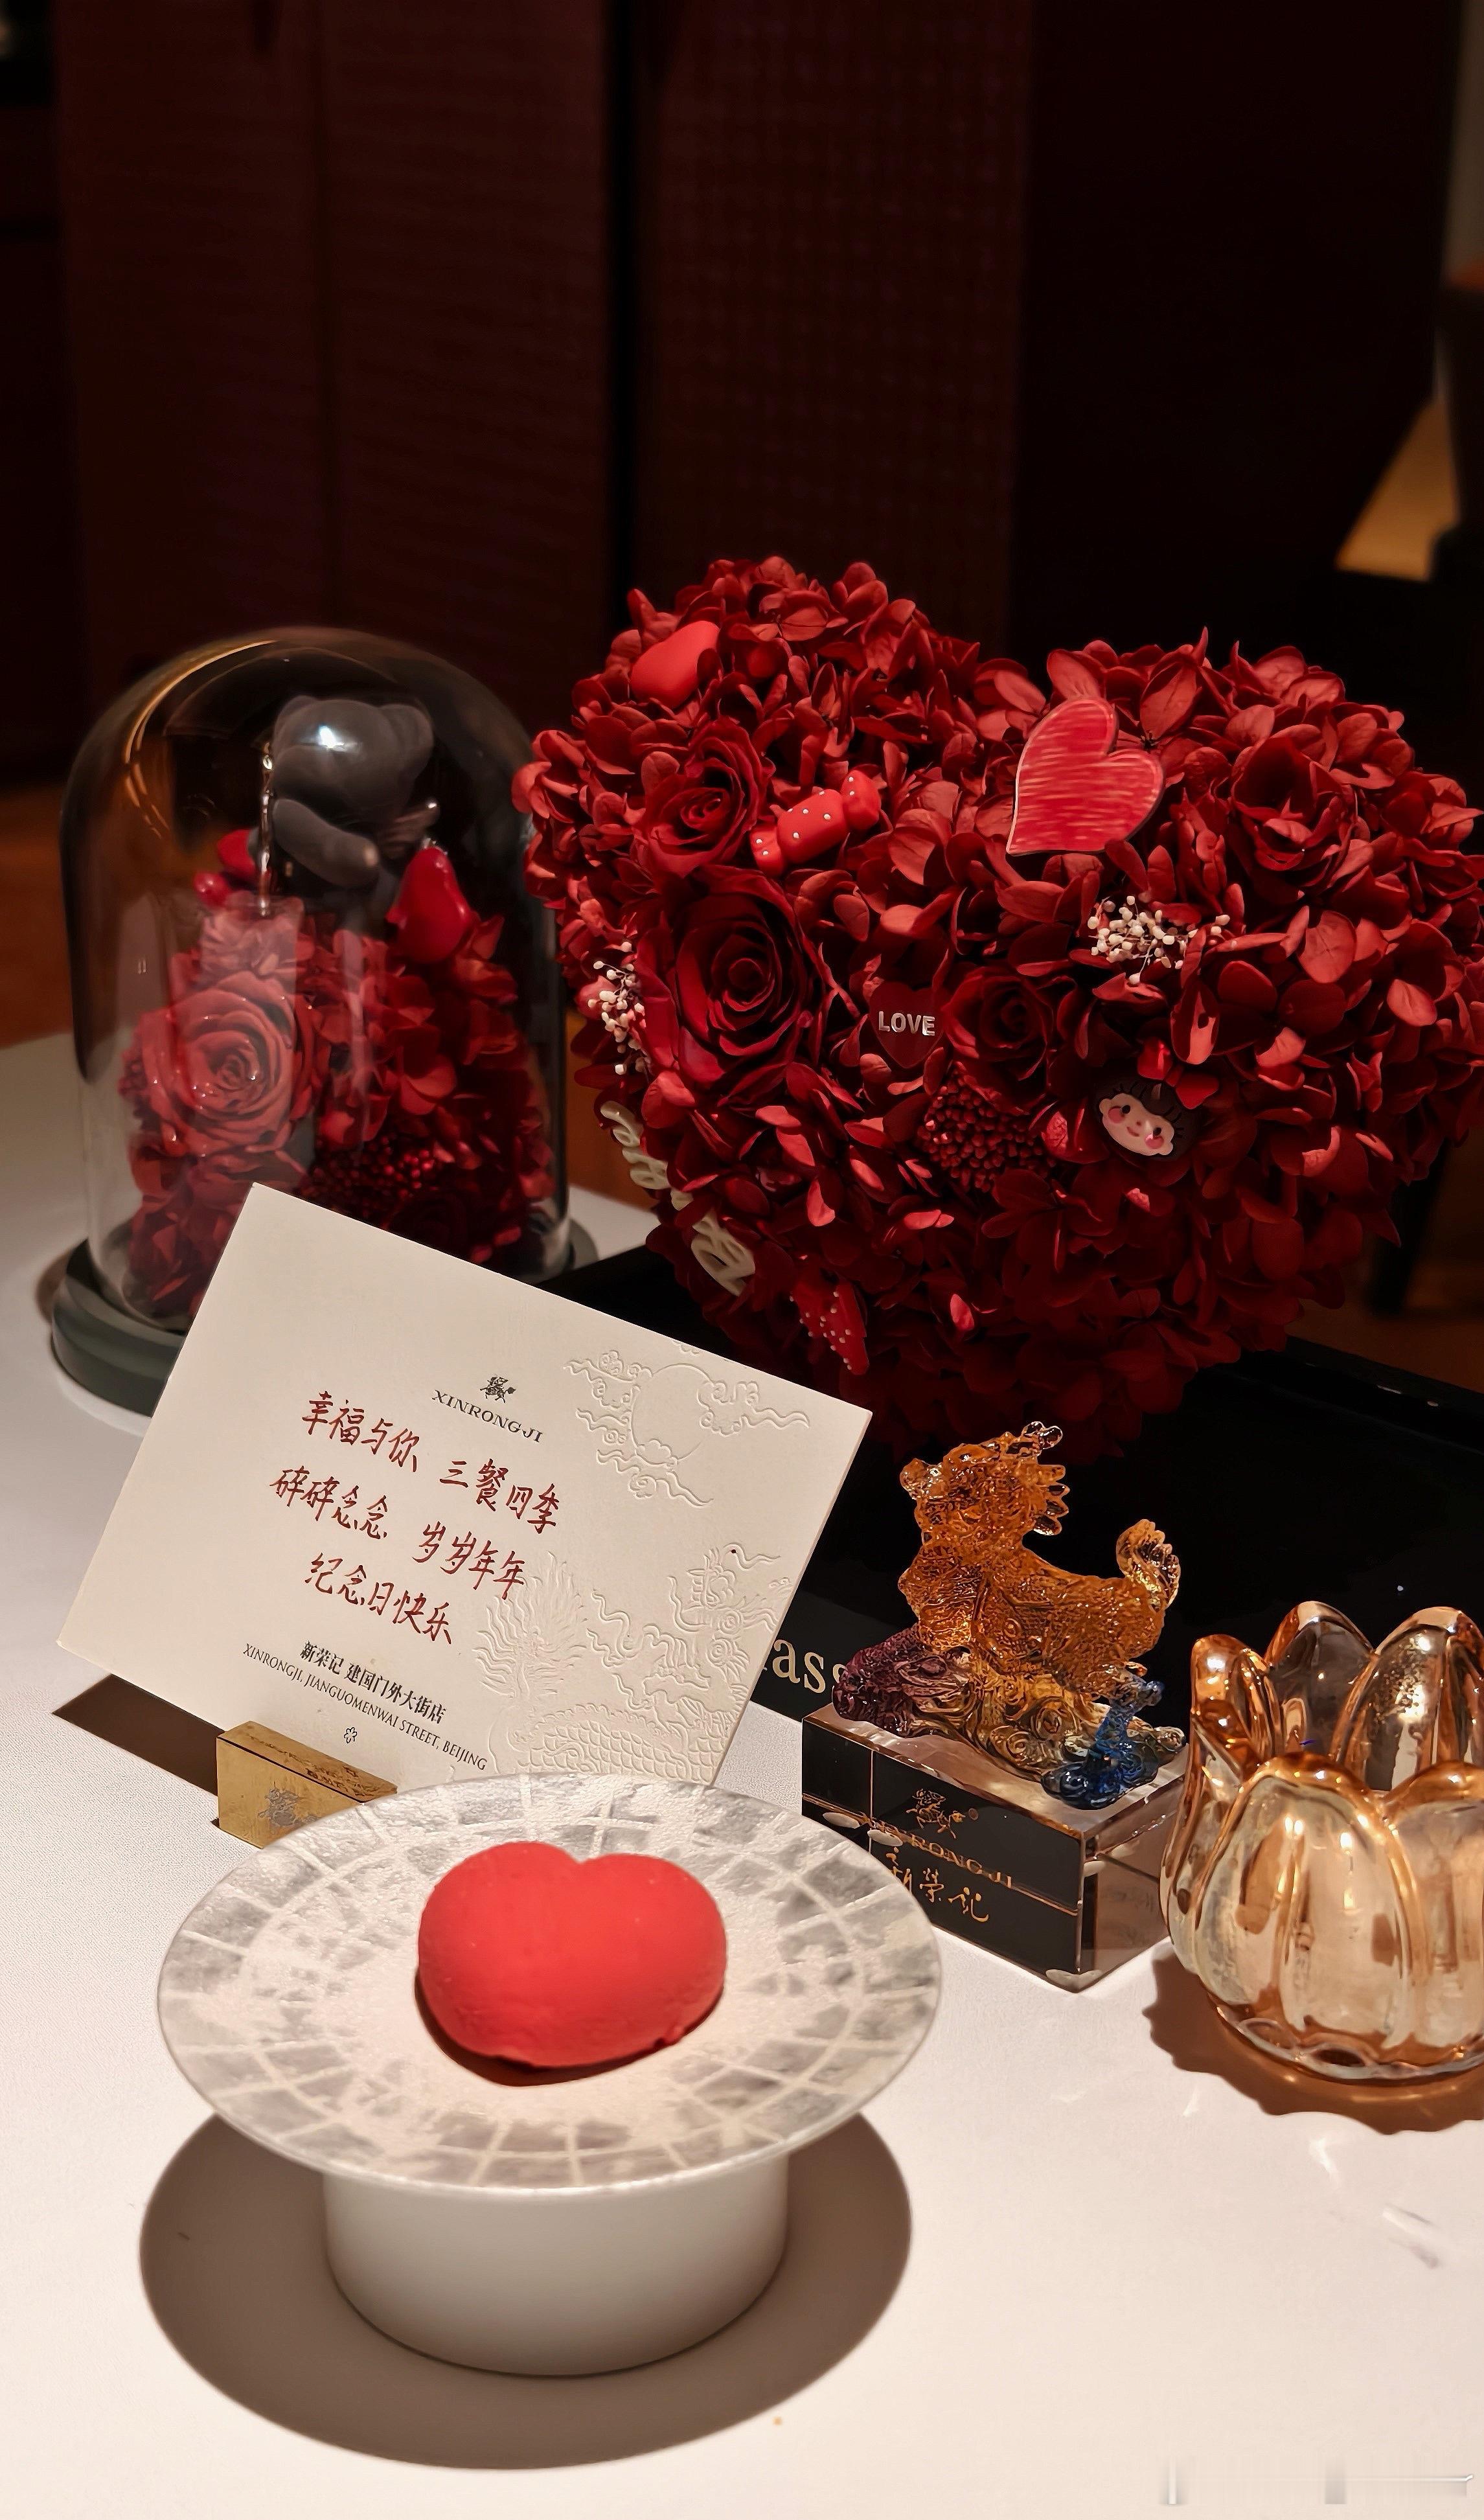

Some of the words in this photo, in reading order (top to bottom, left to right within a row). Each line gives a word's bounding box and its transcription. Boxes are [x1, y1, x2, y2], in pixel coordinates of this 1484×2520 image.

[878, 1011, 935, 1037] LOVE
[302, 1391, 420, 1472] 幸福与你
[439, 1458, 560, 1534] 三餐四季
[431, 1389, 543, 1443] XINRONGJI
[269, 1465, 389, 1540] 碎碎念念
[411, 1521, 526, 1600] 岁岁年年
[304, 1552, 452, 1645] 纪念日快乐
[299, 1640, 345, 1675] 新荣记
[343, 1662, 447, 1724] 建国门外大街店
[303, 1673, 399, 1728] JIANGUOMENWAI
[398, 1719, 441, 1750] STREET,
[442, 1740, 488, 1770] BEIJING
